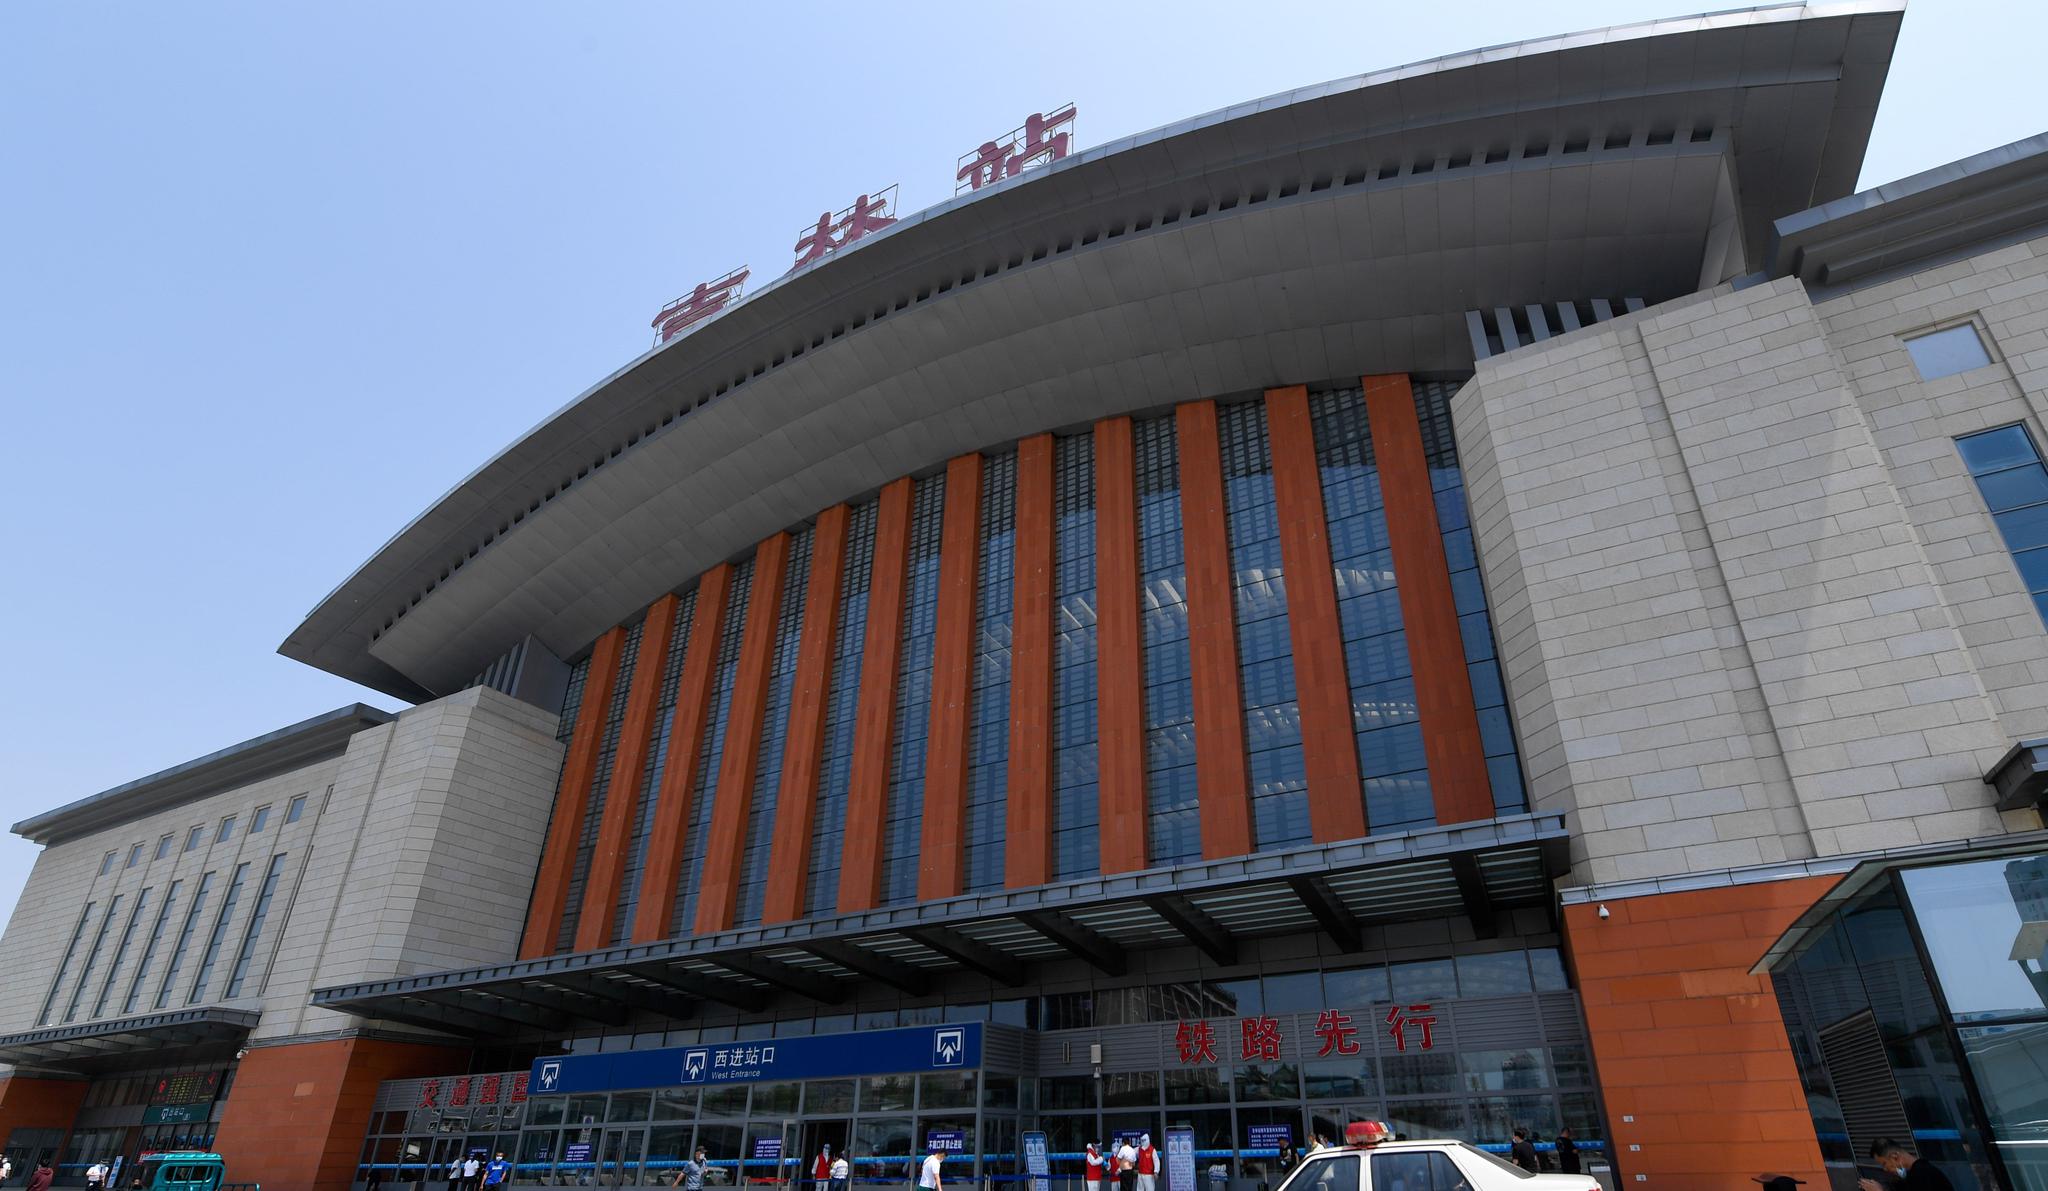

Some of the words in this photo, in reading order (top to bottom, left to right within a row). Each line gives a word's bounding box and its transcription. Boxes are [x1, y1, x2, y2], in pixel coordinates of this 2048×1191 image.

[651, 106, 1077, 342] 吉林站
[1175, 1004, 1438, 1065] 铁路先行
[711, 1071, 728, 1080] West
[730, 1069, 761, 1079] Entrance
[714, 1046, 775, 1068] 西进站口
[418, 1072, 530, 1109] 交通强国
